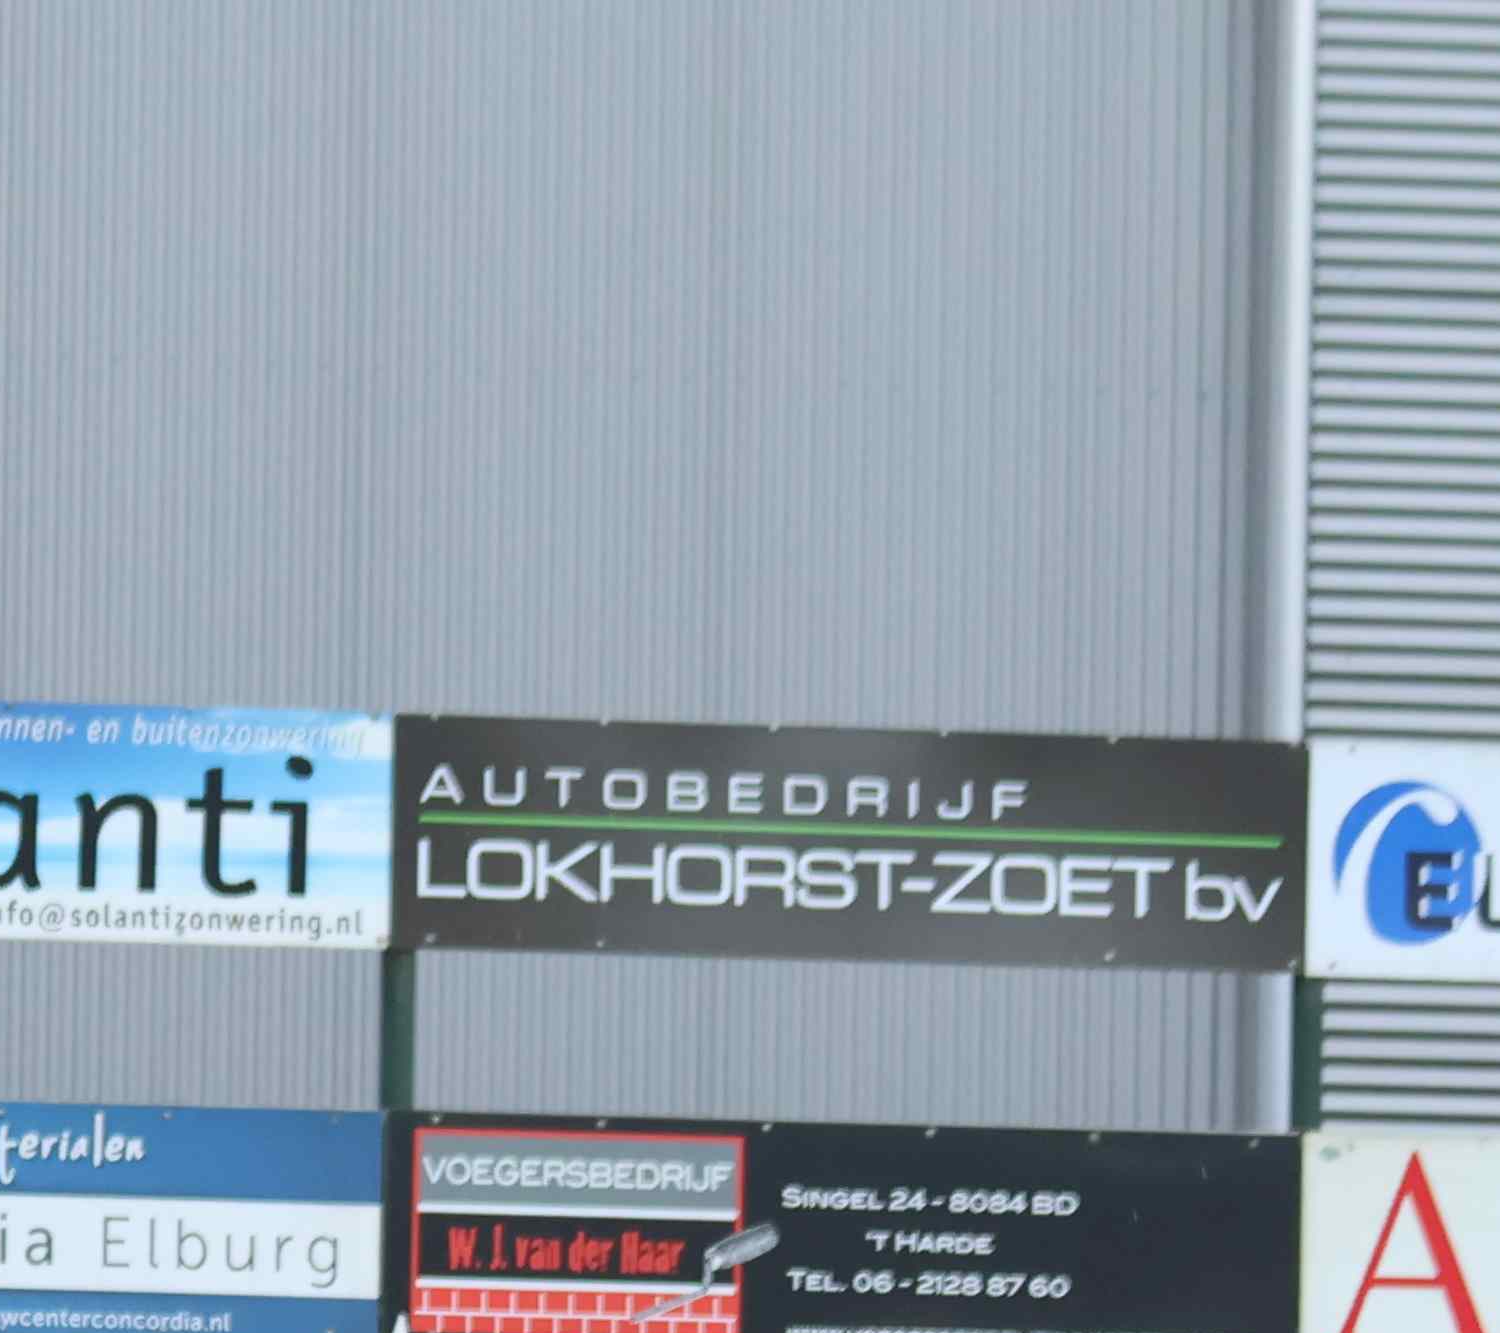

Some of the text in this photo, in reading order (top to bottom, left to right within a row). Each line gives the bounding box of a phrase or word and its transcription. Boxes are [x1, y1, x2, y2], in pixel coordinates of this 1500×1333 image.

[87, 717, 121, 743] en
[132, 711, 365, 757] buitenzonwering
[419, 764, 1029, 821] AUTOBEDRIJF
[417, 839, 1284, 923] LOKHORST-ZOET bv
[423, 1155, 735, 1193] VOEGERSBEDRIJF
[888, 1187, 927, 1212] 24
[1031, 1192, 1081, 1216] BD
[102, 1215, 341, 1290] Elburg
[448, 1226, 483, 1271] W.
[515, 1236, 562, 1271] van
[568, 1230, 614, 1273] der
[852, 1270, 895, 1294] 06
[915, 1272, 984, 1296] 2128
[985, 1273, 1027, 1298] 87
[1027, 1275, 1072, 1299] 60
